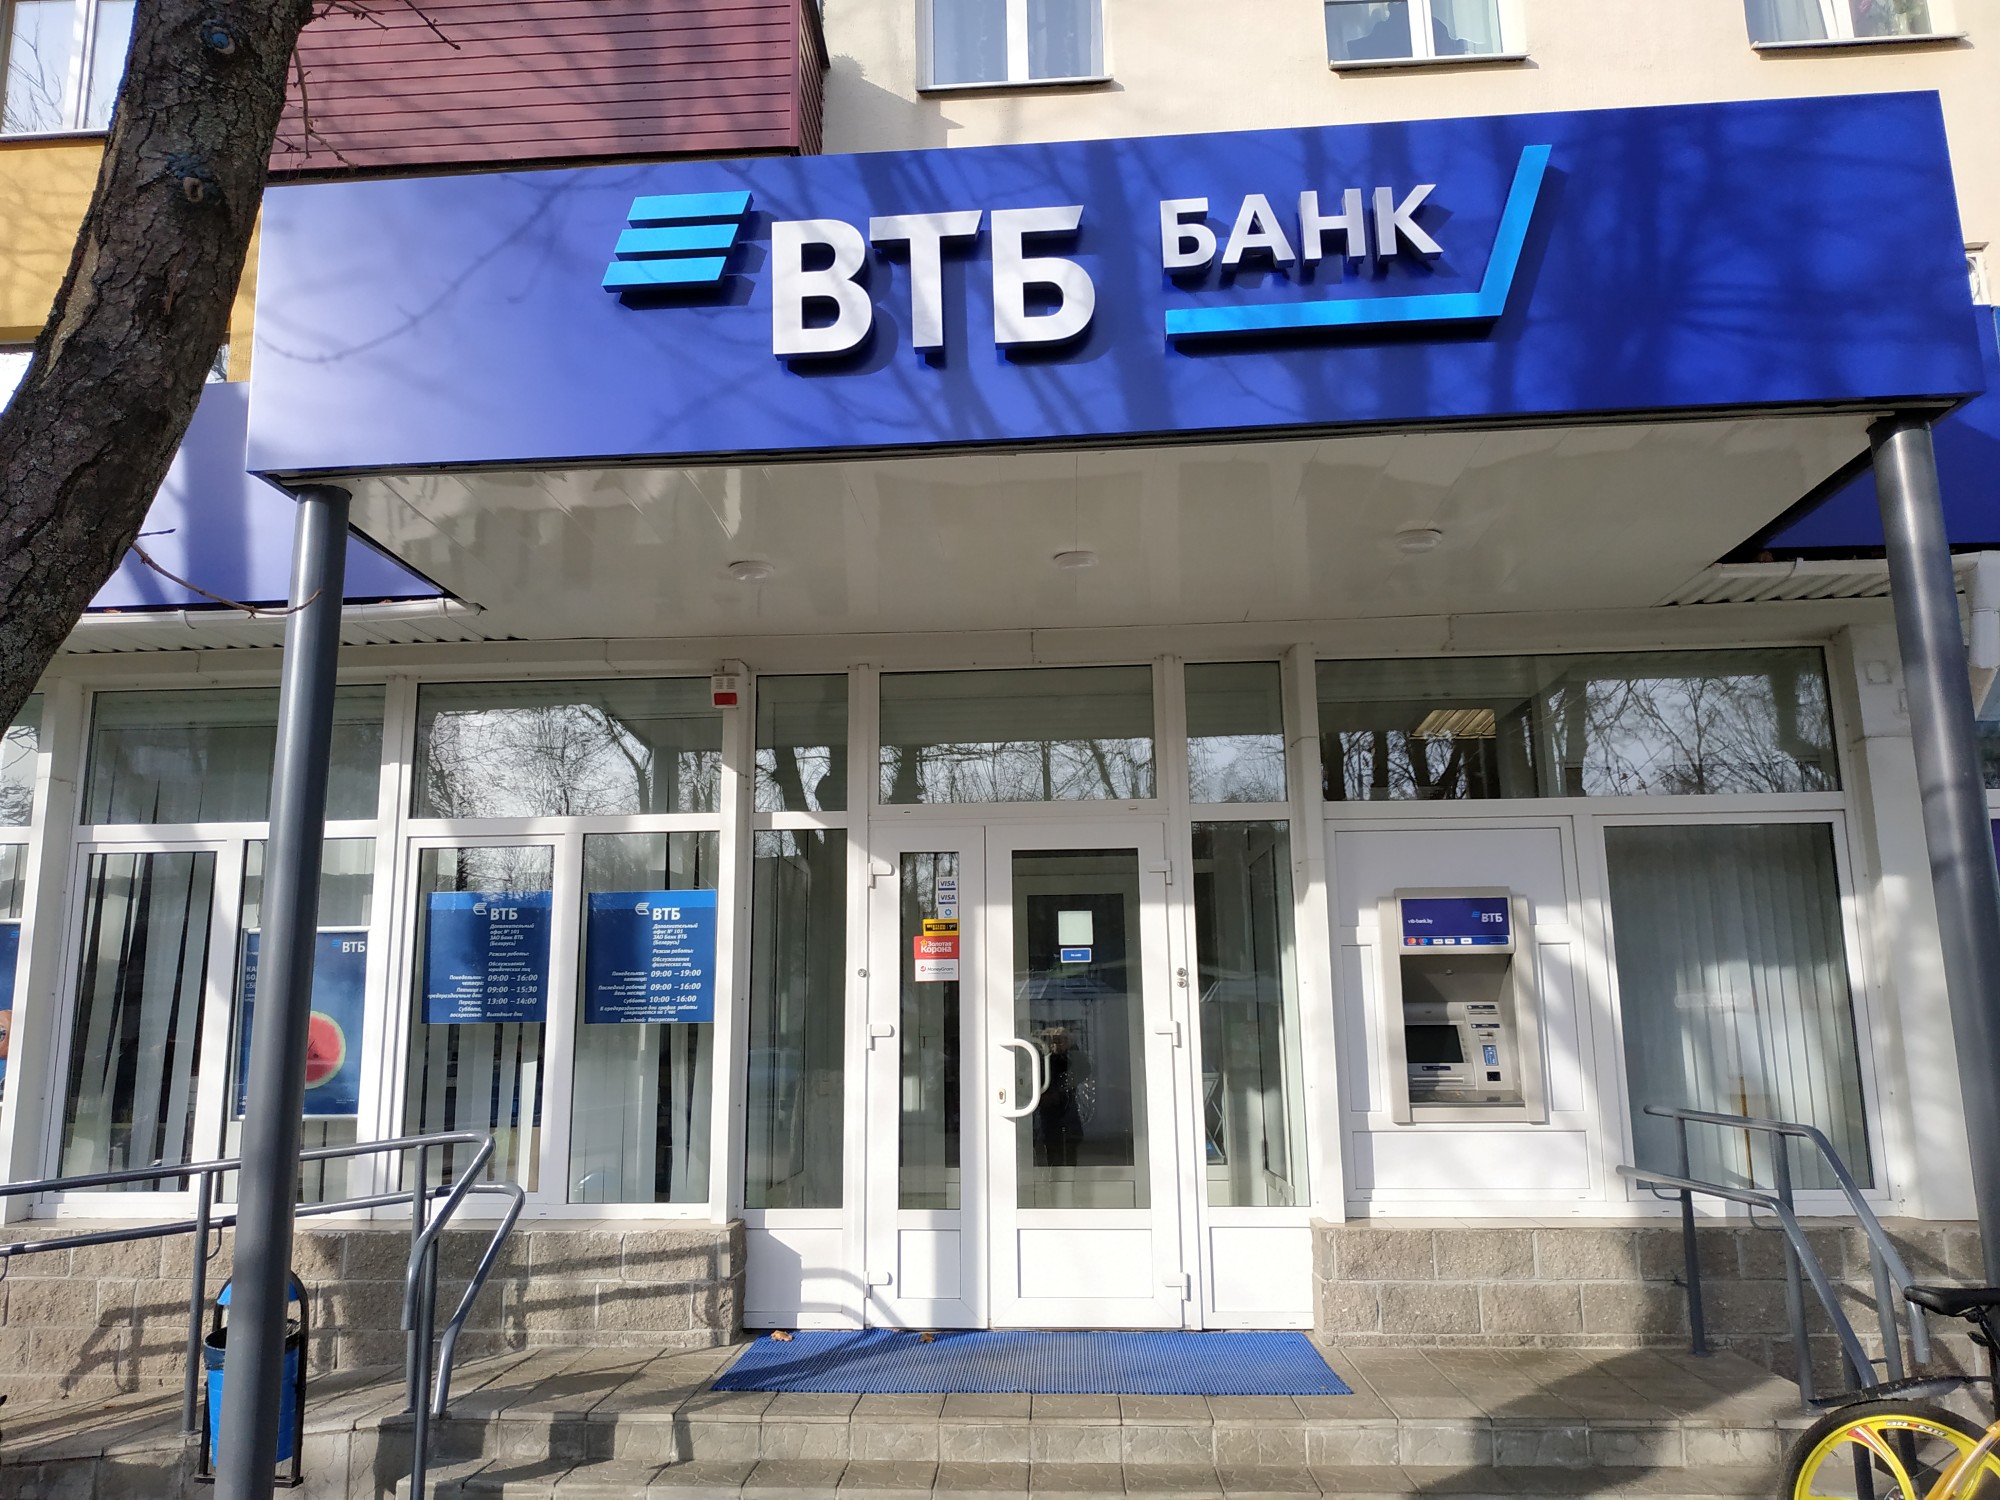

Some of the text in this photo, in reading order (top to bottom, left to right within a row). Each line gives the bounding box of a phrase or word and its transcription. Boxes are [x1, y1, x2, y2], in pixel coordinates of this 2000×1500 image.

[771, 184, 1444, 355] ВТБ БАНК
[490, 907, 518, 920] ВТБ
[652, 907, 681, 920] ВТБ
[1481, 912, 1504, 923] ВТБ
[342, 941, 366, 953] ВТБ
[920, 946, 952, 954] Корона
[487, 974, 509, 982] 09:00
[650, 970, 673, 978] 09:00
[650, 983, 672, 991] 09:00
[486, 997, 508, 1005] 13:00
